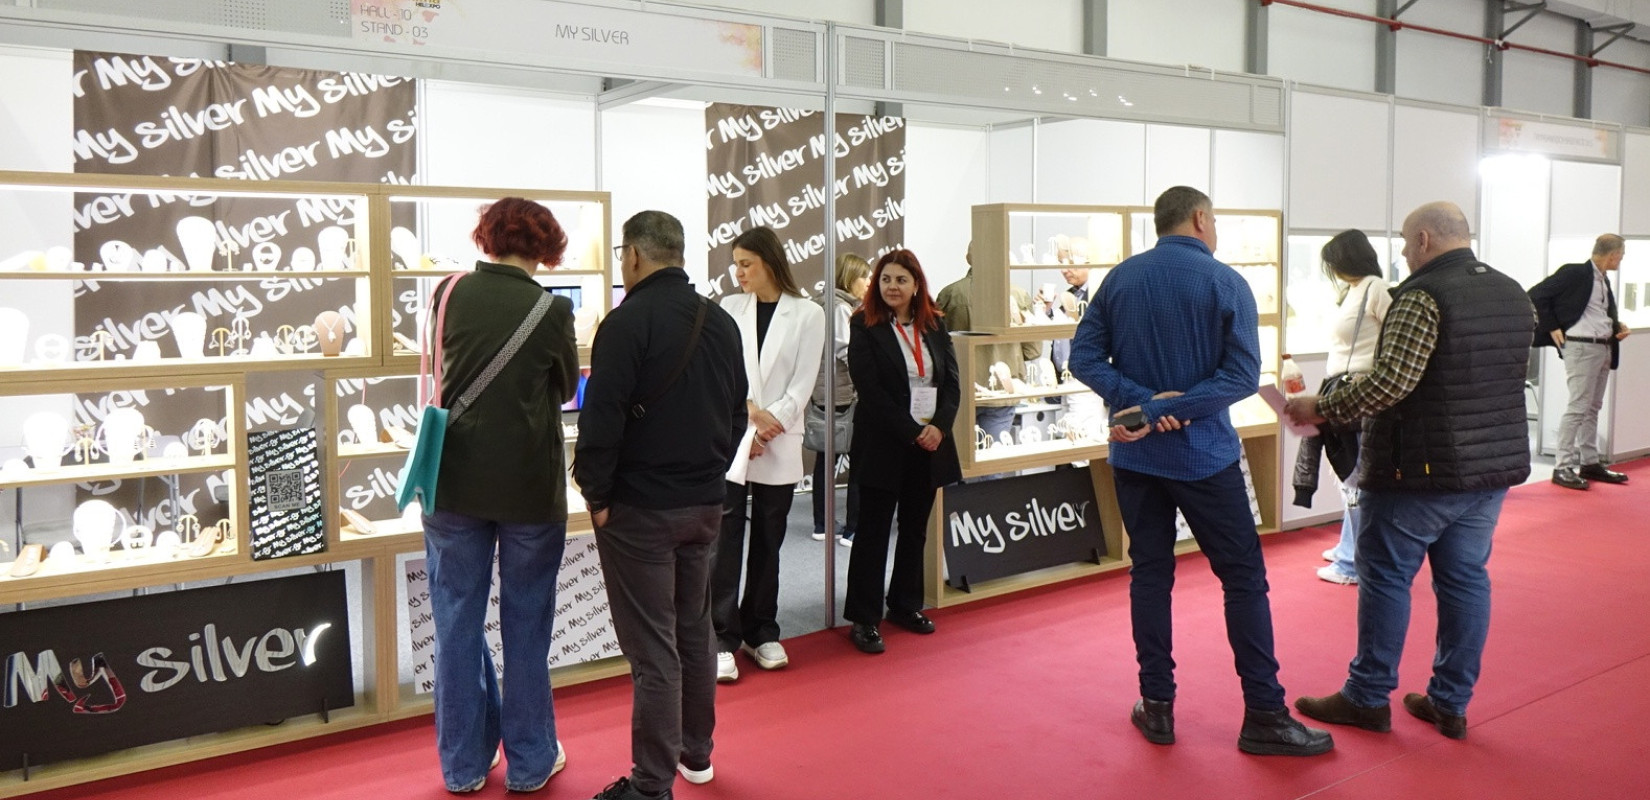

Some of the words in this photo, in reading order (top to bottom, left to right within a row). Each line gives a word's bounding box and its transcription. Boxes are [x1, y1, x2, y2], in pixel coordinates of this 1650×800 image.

[360, 5, 390, 19] HALL
[361, 21, 403, 35] STAND
[412, 26, 428, 38] 03
[555, 24, 578, 39] MY
[582, 27, 629, 45] SILVER
[94, 55, 172, 91] My
[73, 128, 138, 164] My
[135, 98, 247, 149] silver
[251, 84, 321, 118] My
[718, 114, 763, 142] My
[325, 125, 390, 159] My
[706, 171, 746, 198] My
[742, 145, 806, 185] silver
[749, 201, 790, 229] My
[853, 162, 889, 187] My
[836, 215, 875, 242] My
[872, 197, 905, 228] silv
[346, 467, 404, 510] silv
[950, 510, 1006, 553] My
[1005, 498, 1090, 541] silver
[560, 551, 585, 571] silver
[580, 565, 600, 578] My
[406, 570, 428, 583] My
[574, 590, 593, 604] My
[412, 613, 432, 629] silv
[568, 616, 588, 629] My
[412, 633, 435, 652] ilver
[562, 642, 581, 656] My
[579, 625, 607, 647] silver
[3, 649, 127, 714] My
[136, 622, 332, 693] silver
